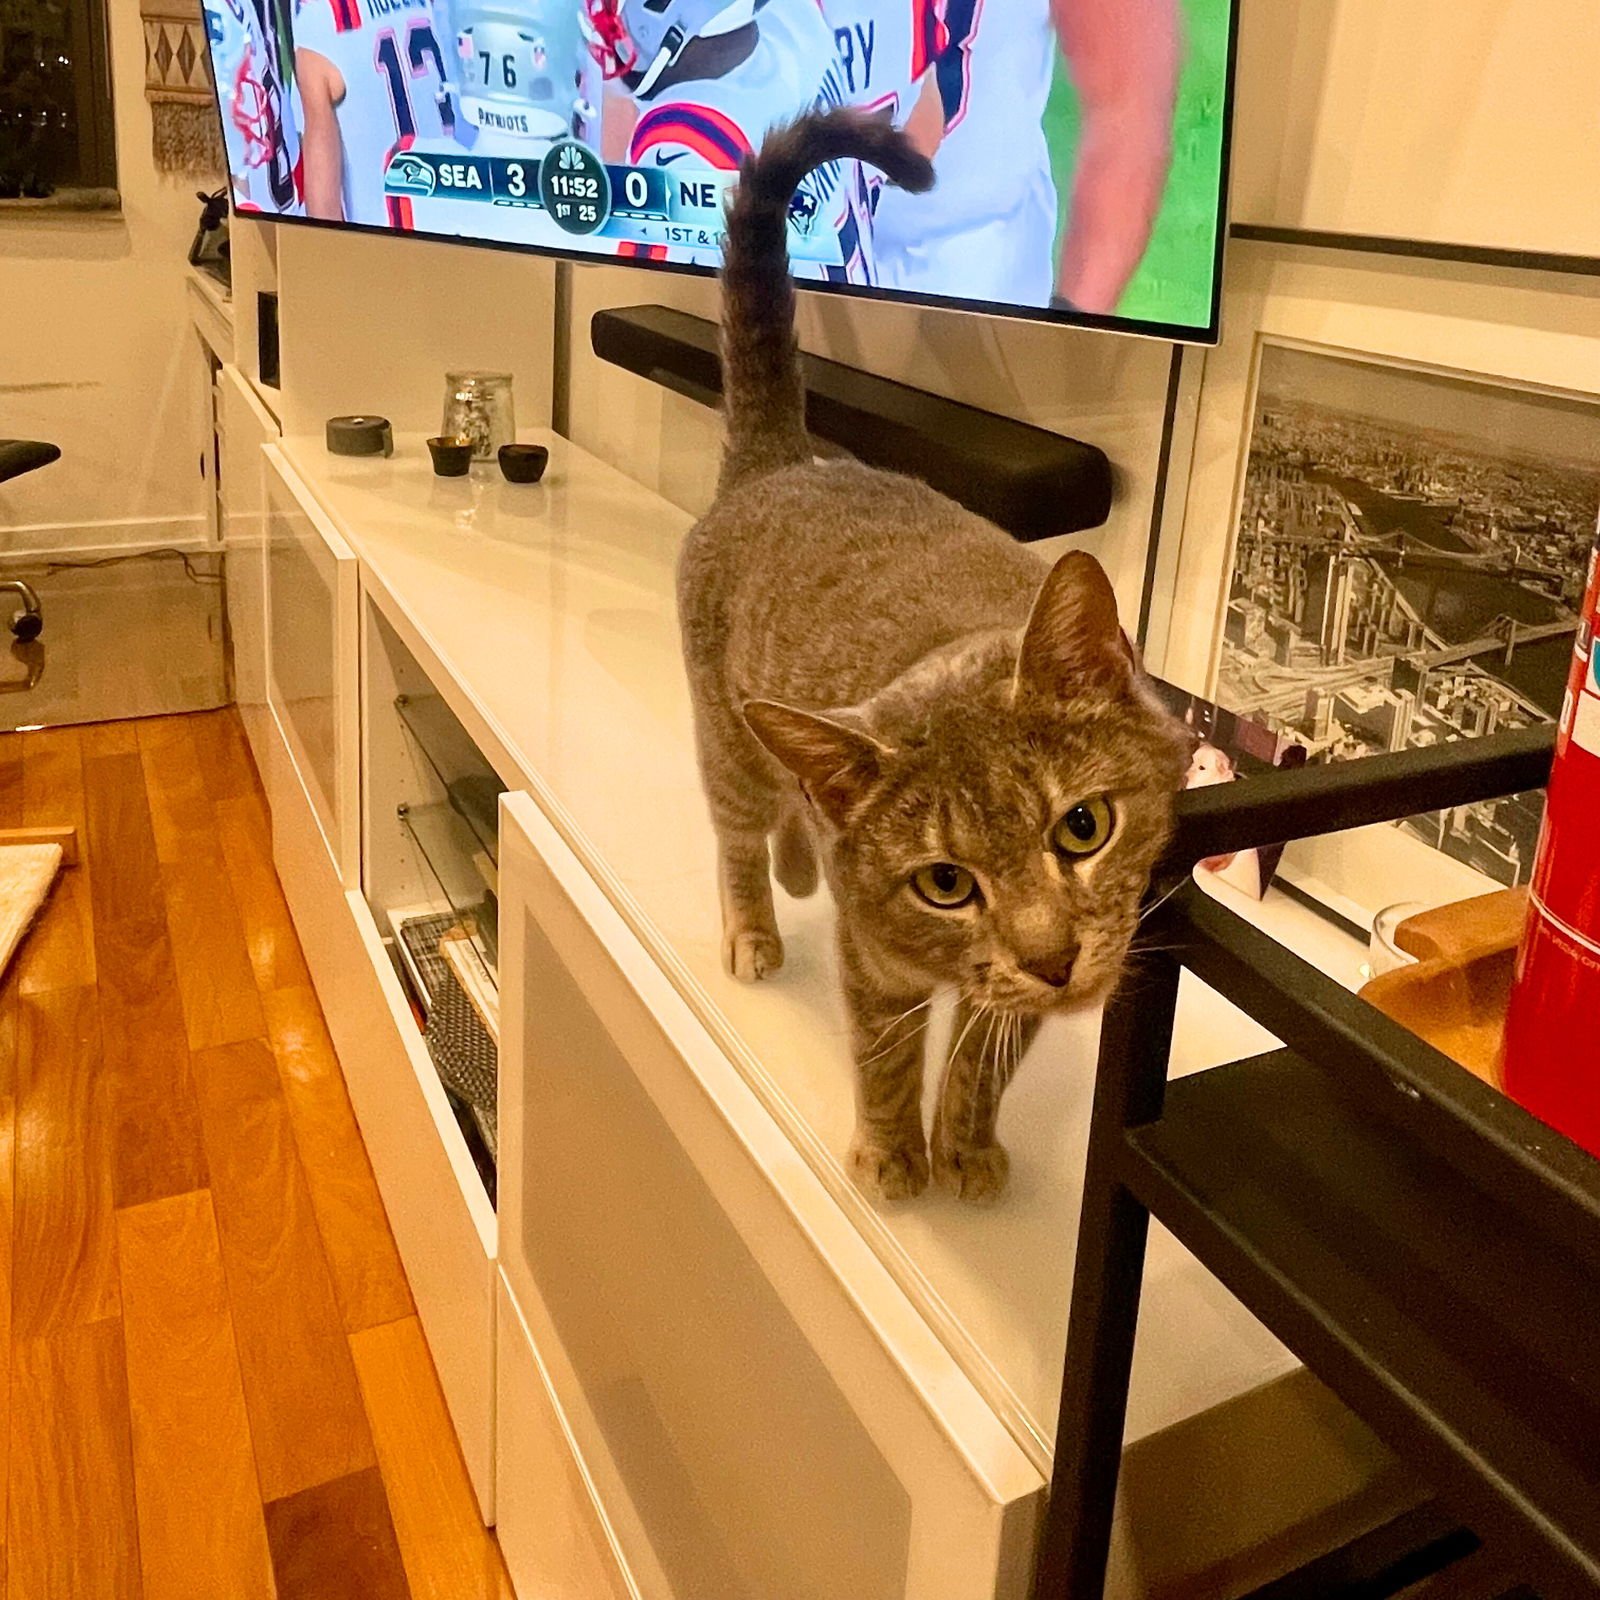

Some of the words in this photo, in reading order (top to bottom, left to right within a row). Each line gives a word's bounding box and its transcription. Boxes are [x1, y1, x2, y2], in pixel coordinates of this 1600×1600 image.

[478, 50, 517, 88] 76
[478, 106, 529, 133] PATRIOTS
[438, 163, 483, 190] SEA
[506, 163, 527, 197] 3
[550, 175, 599, 199] 11:52
[625, 171, 648, 208] 0
[680, 182, 717, 208] NE
[579, 204, 597, 222] 25
[664, 227, 693, 242] 1ST
[697, 230, 710, 245] &
